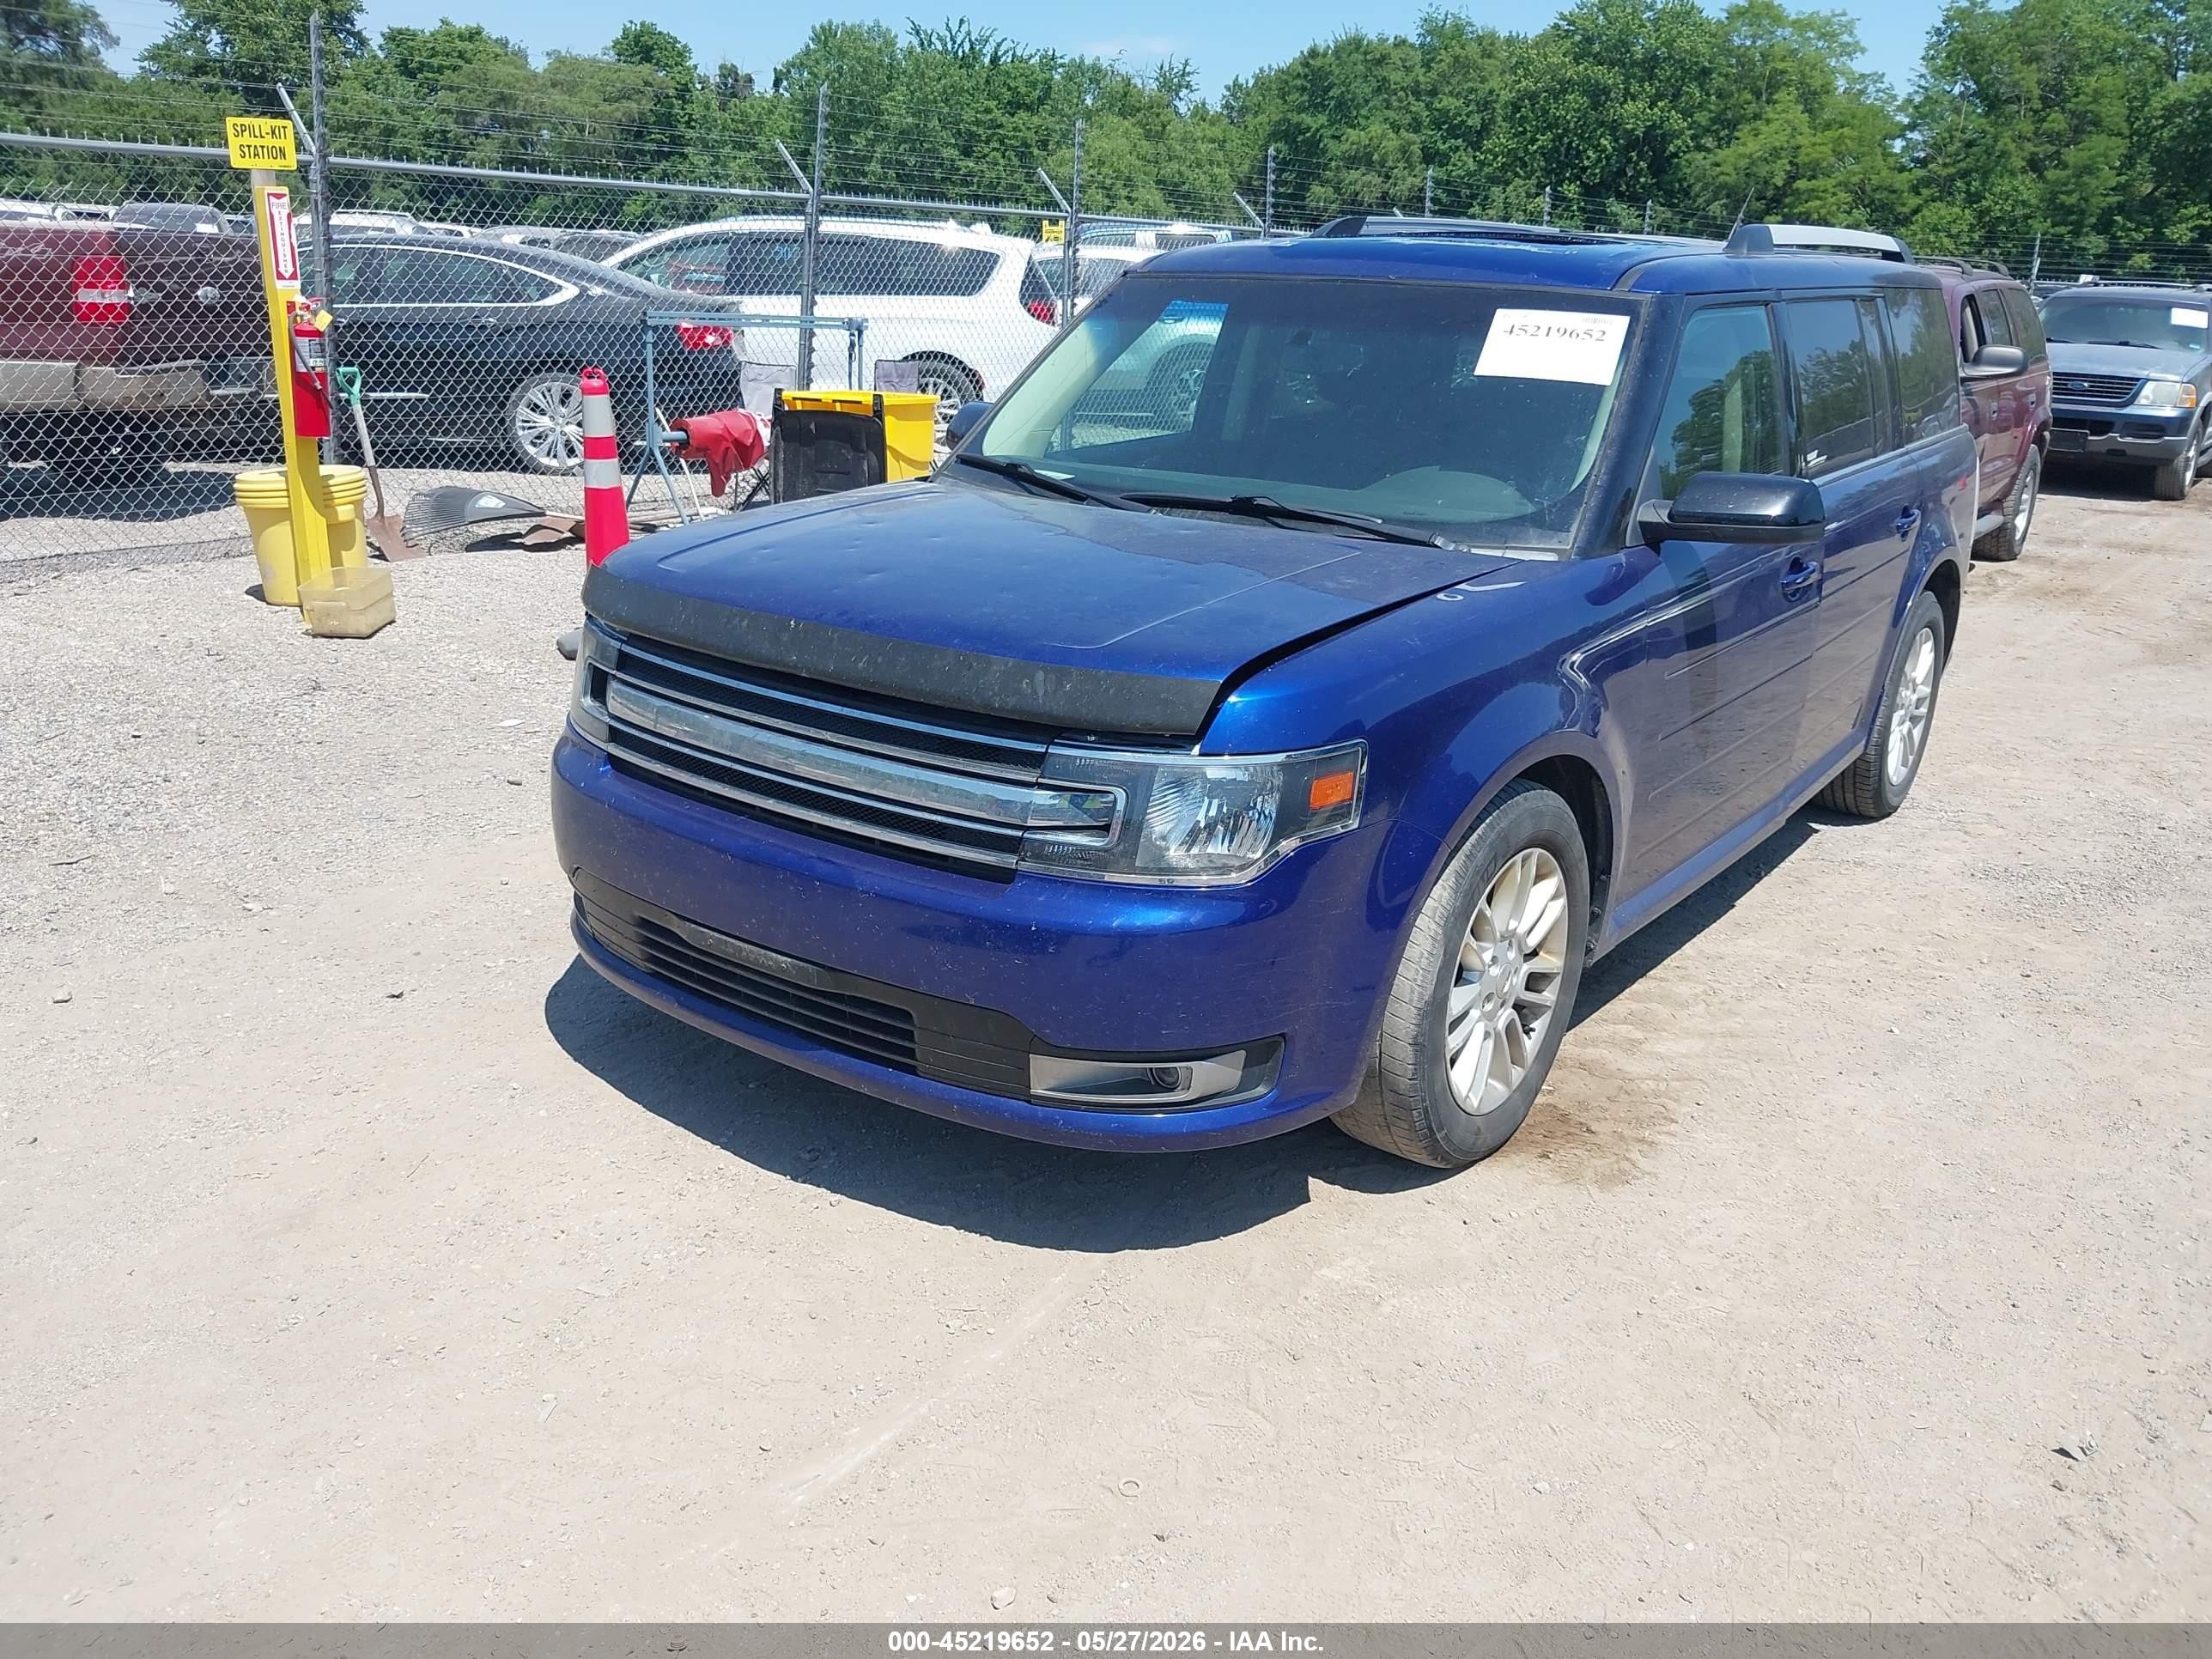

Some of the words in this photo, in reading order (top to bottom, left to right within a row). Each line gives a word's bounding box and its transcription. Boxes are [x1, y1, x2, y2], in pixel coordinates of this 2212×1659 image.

[232, 123, 289, 140] SPILL-KIT
[239, 143, 288, 161] STATION
[271, 202, 288, 210] FIRE
[1504, 324, 1606, 342] 45219652
